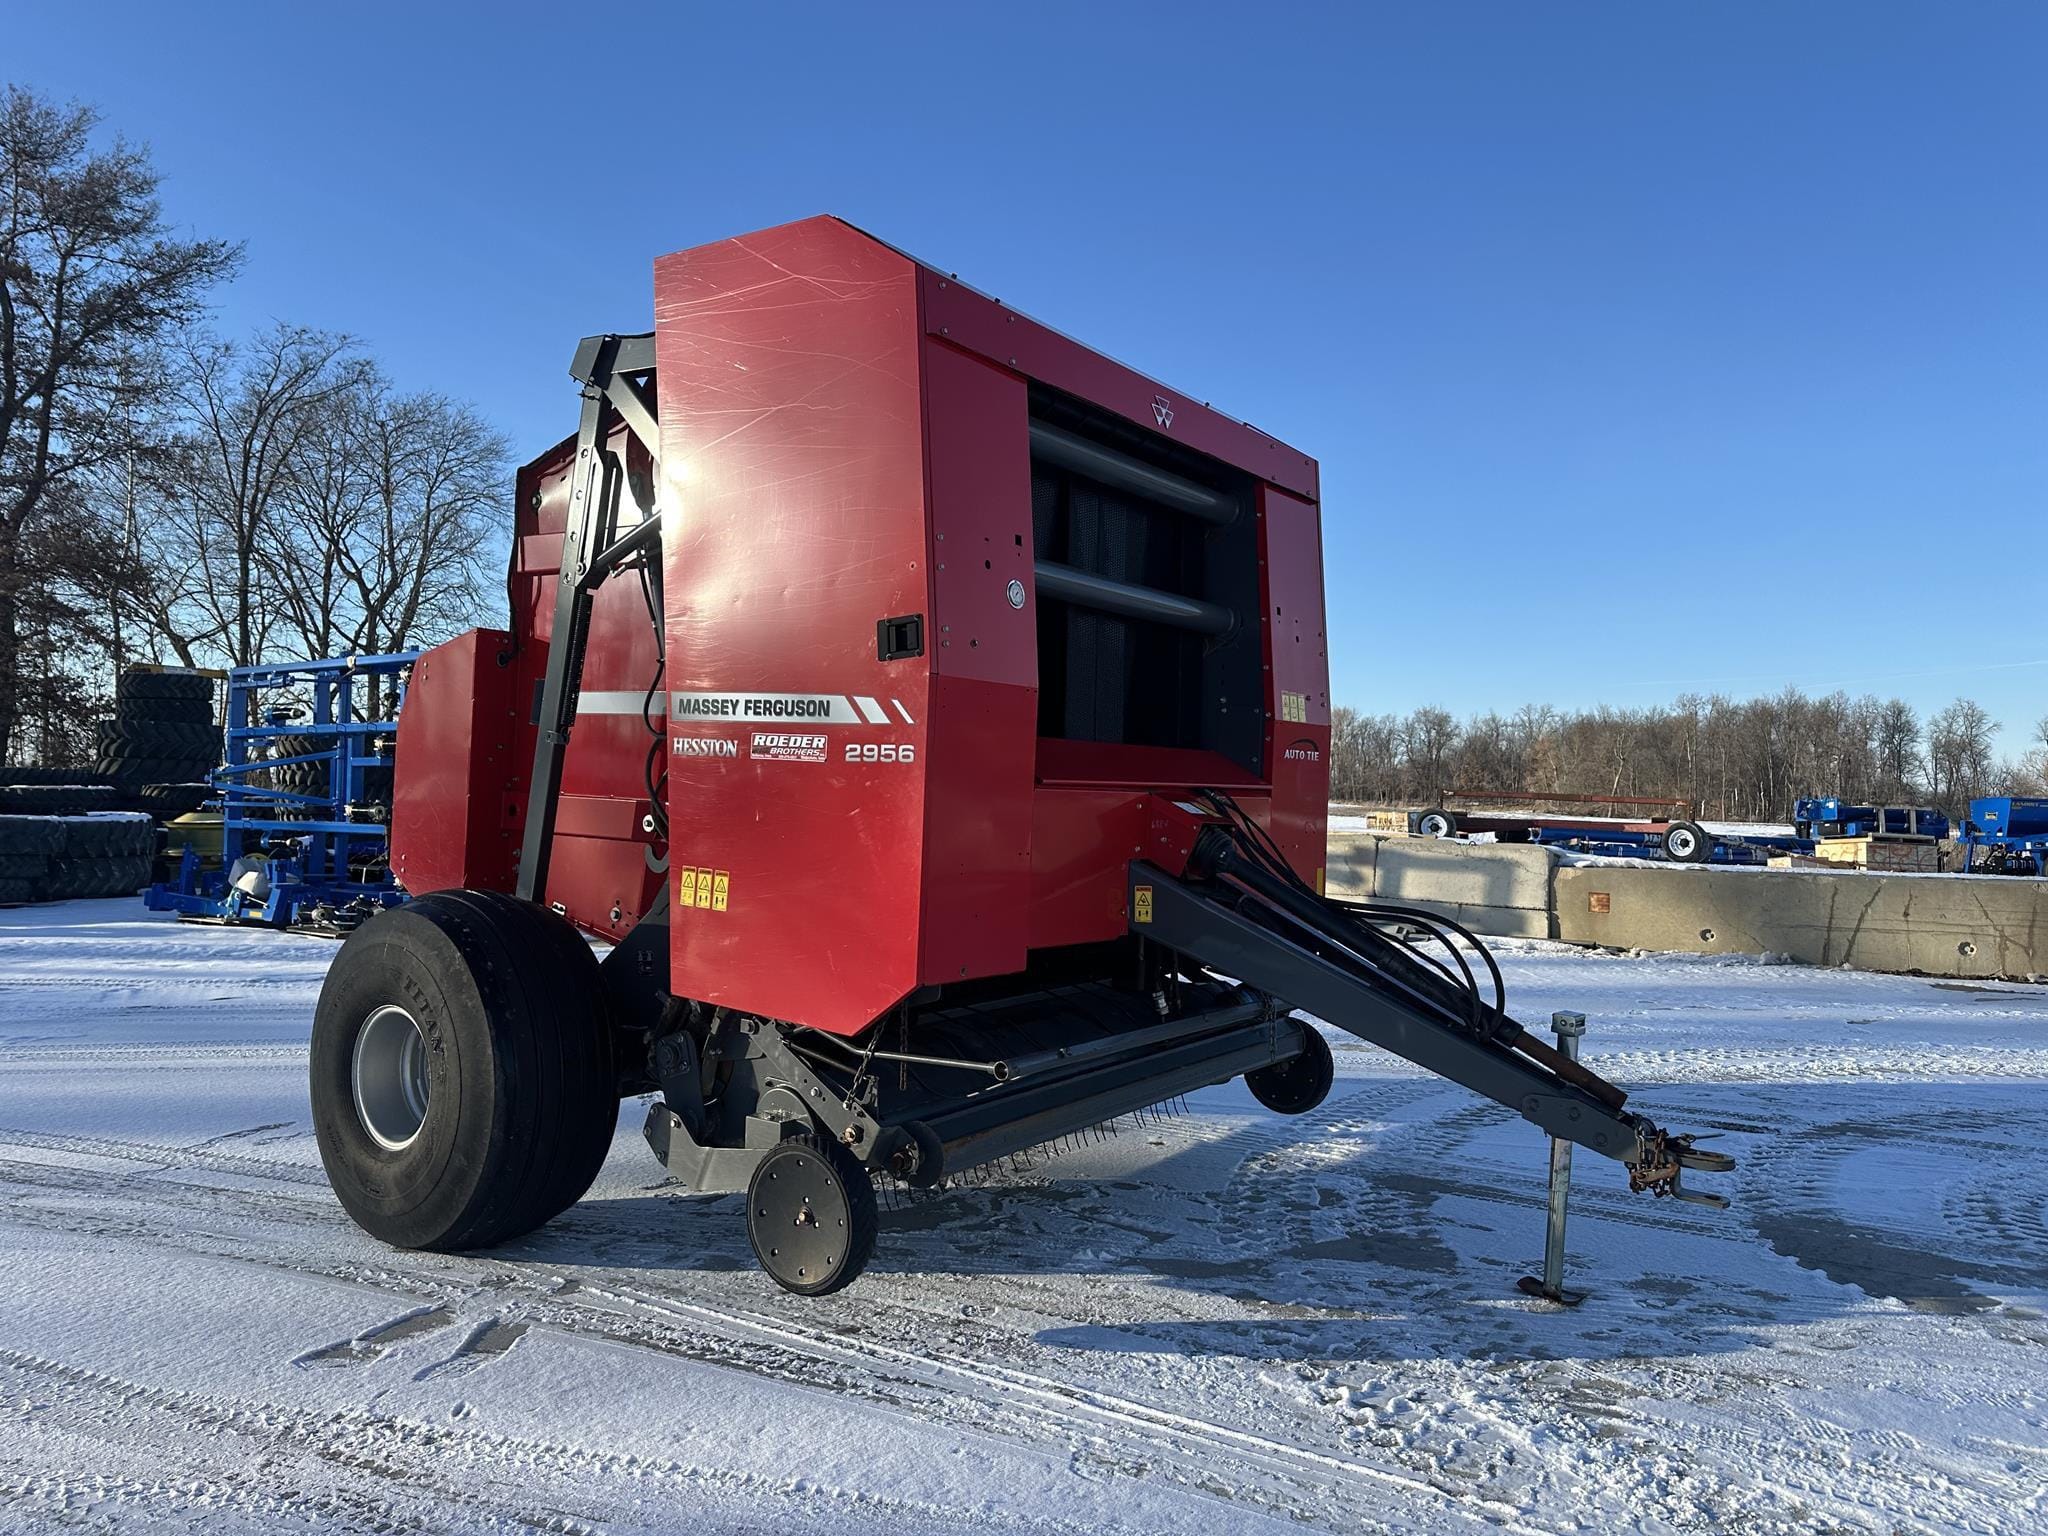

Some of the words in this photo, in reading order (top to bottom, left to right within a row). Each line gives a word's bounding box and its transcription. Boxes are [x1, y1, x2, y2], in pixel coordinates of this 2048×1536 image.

[678, 698, 740, 716] MASSEY
[743, 699, 831, 717] FERGUSON
[672, 737, 738, 758] HESSTON
[753, 735, 826, 753] ROEDER
[769, 747, 820, 756] BROTHERS
[845, 744, 915, 762] 2956
[1284, 749, 1305, 760] AUTO
[1307, 751, 1320, 761] TIE
[403, 974, 445, 1056] TITAN
